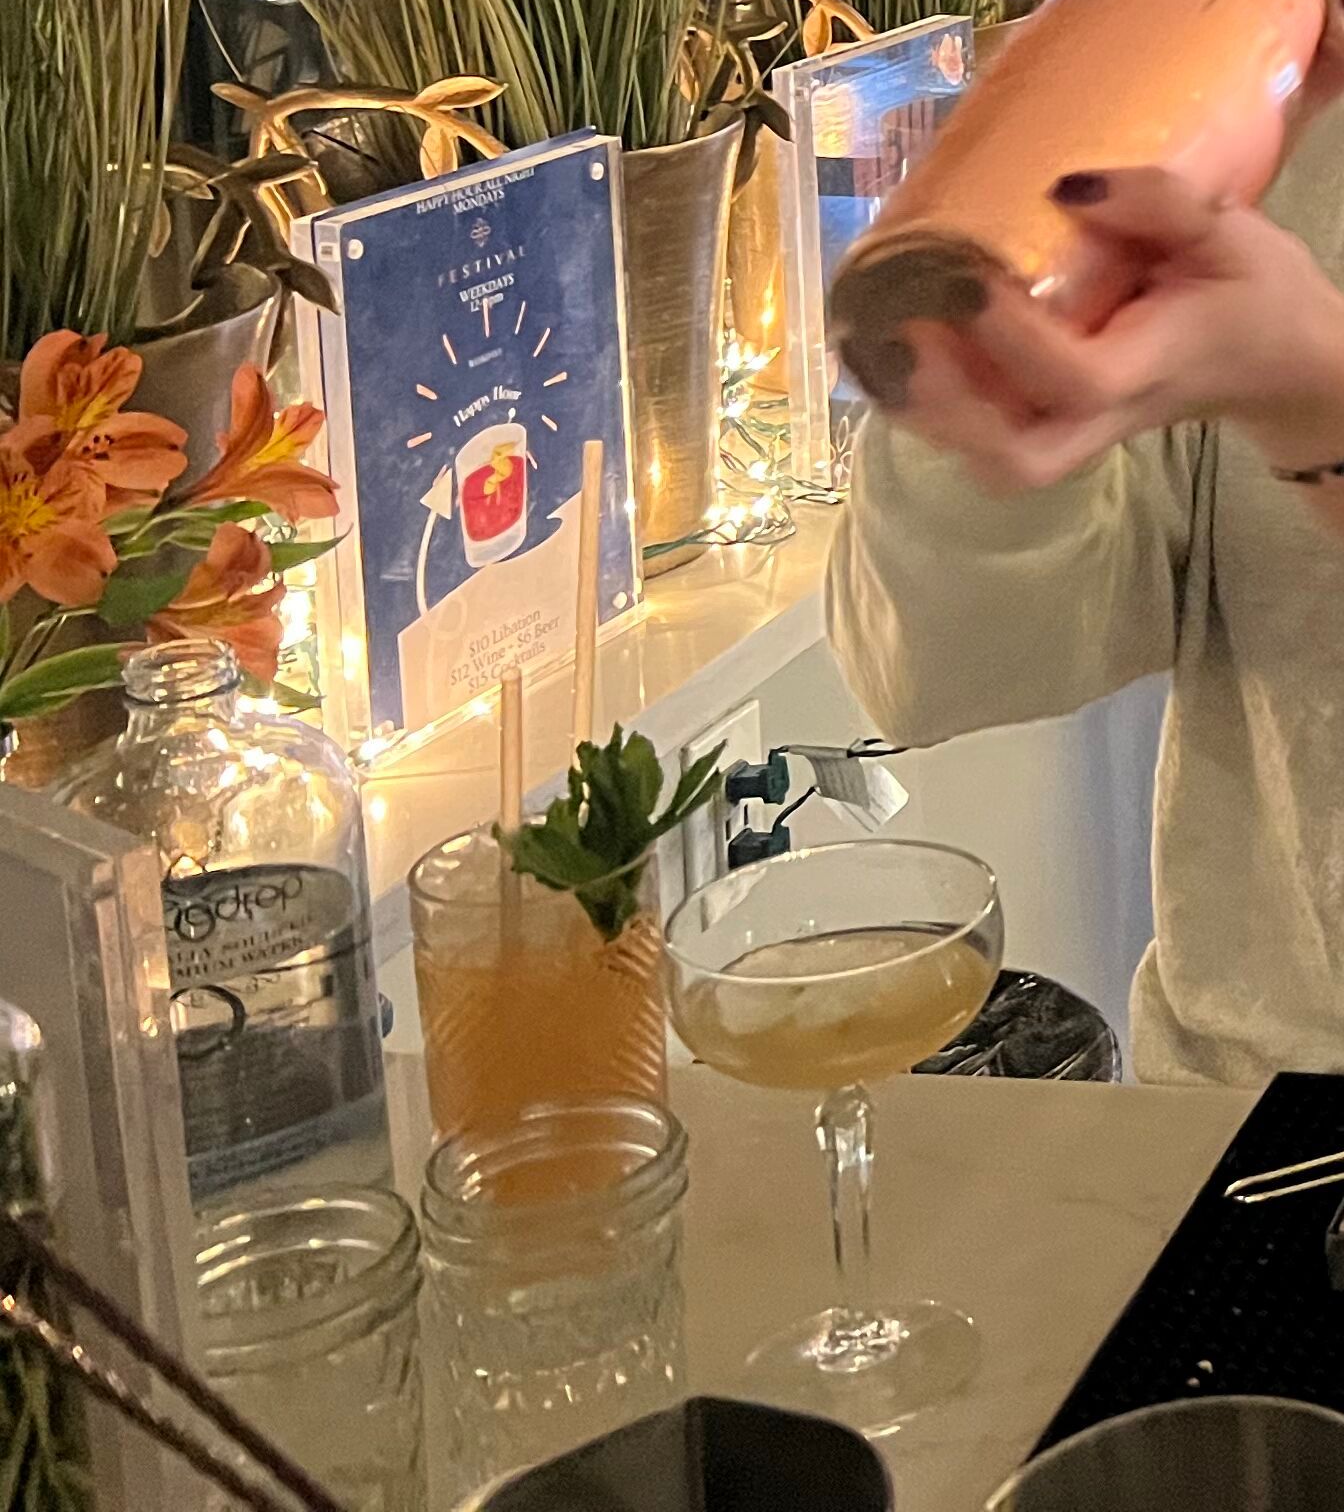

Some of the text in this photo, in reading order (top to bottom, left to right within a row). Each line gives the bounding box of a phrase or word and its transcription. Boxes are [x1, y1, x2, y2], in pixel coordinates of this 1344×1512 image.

[416, 195, 449, 214] HAPPY
[484, 177, 503, 193] ALL
[454, 189, 505, 215] MONDAYS
[438, 246, 527, 287] FESTIVAL
[459, 273, 514, 302] WEEKDAYS
[453, 385, 522, 427] Happy Hour
[450, 664, 470, 686] $12
[472, 647, 506, 672] Wine
[518, 631, 532, 648] $6
[535, 616, 560, 639] Beer
[469, 610, 541, 658] $10 Libation
[468, 641, 545, 694] $15 Cocktails
